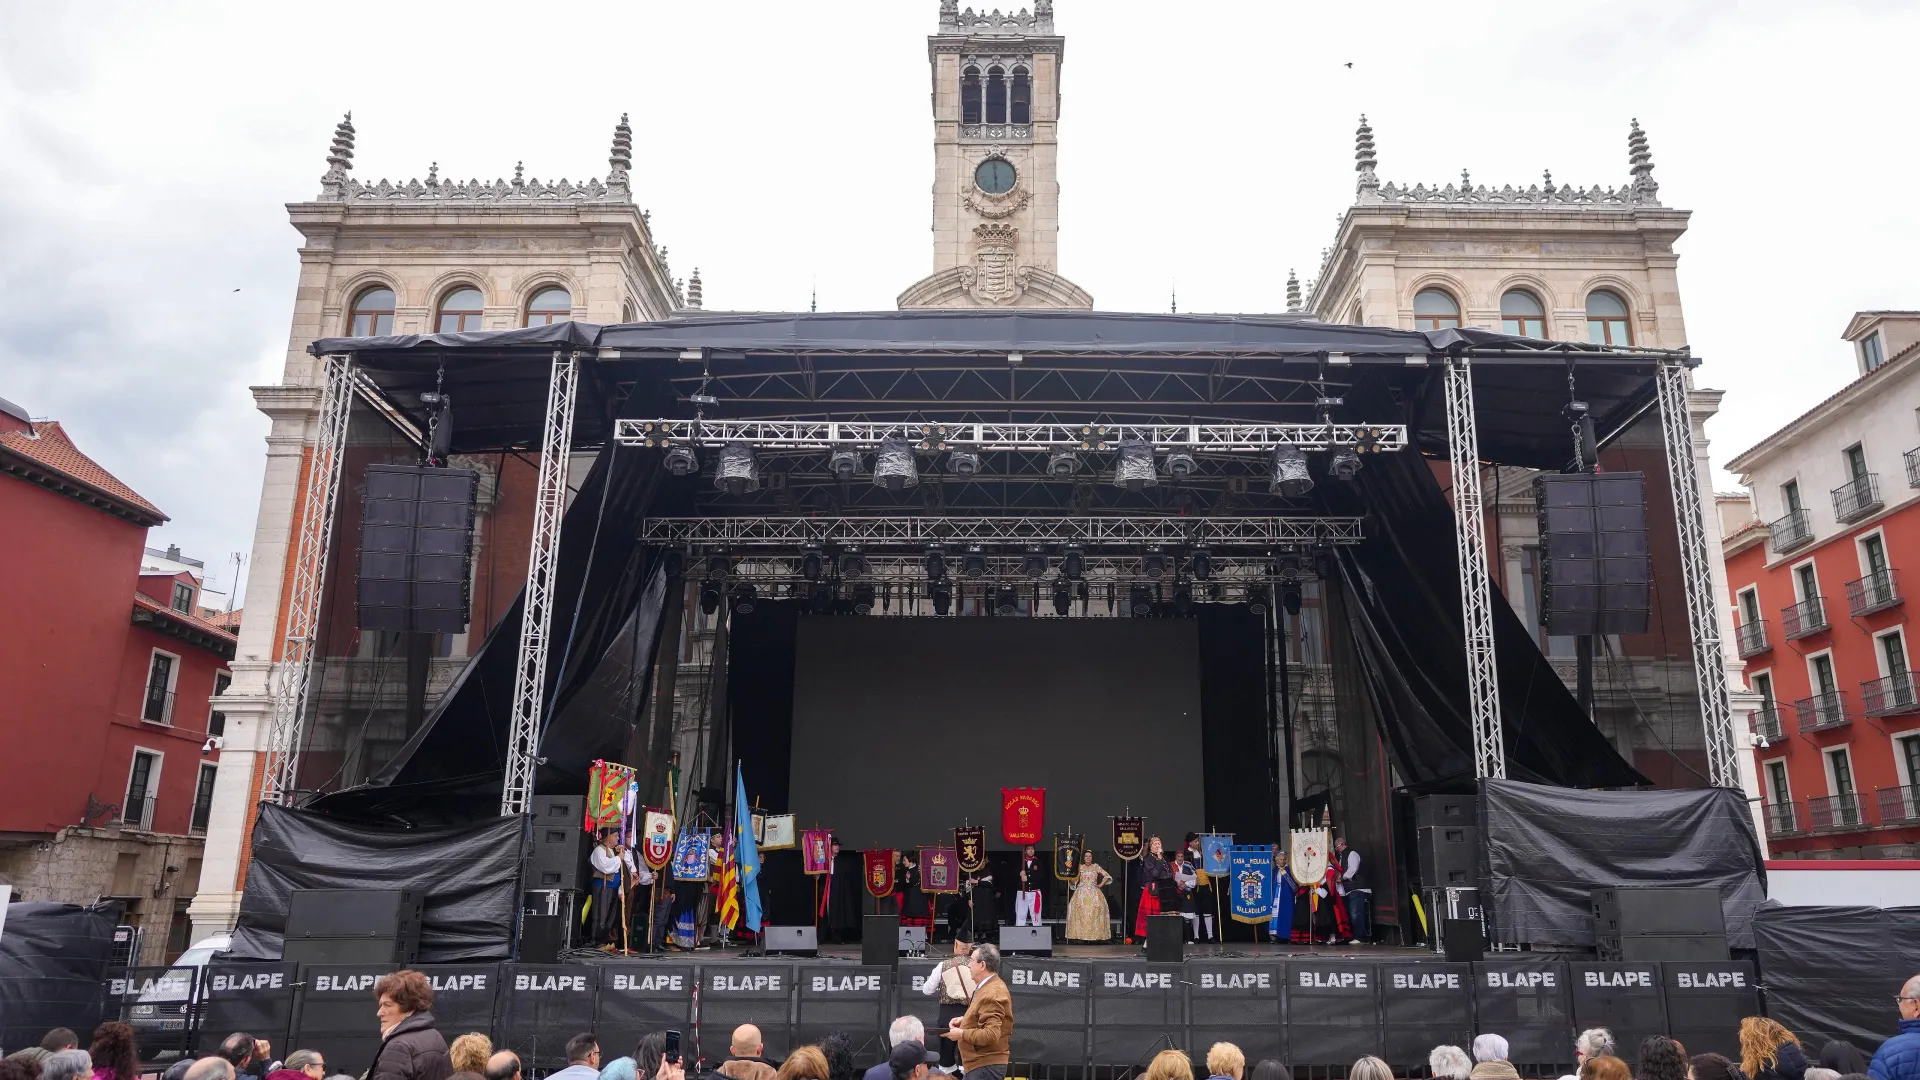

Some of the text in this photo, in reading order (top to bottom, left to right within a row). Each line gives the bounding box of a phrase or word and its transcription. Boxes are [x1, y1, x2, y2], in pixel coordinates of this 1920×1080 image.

[1236, 905, 1267, 914] VALLADOLID
[110, 978, 186, 995] BLAPE
[213, 973, 284, 991] BLAPE
[515, 975, 586, 991] BLAPE
[613, 975, 683, 991] BLAPE
[713, 975, 781, 991] BLAPE
[812, 976, 881, 992] BLAPE
[1012, 969, 1080, 988] BLAPE
[1103, 972, 1172, 989] BLAPE
[1201, 973, 1270, 989] BLAPE
[1300, 972, 1367, 988] BLAPE
[1393, 974, 1460, 989] BLAPE
[1487, 972, 1556, 987] BLAPE
[1584, 972, 1651, 987] BLAPE
[1677, 972, 1746, 988] BLAPE
